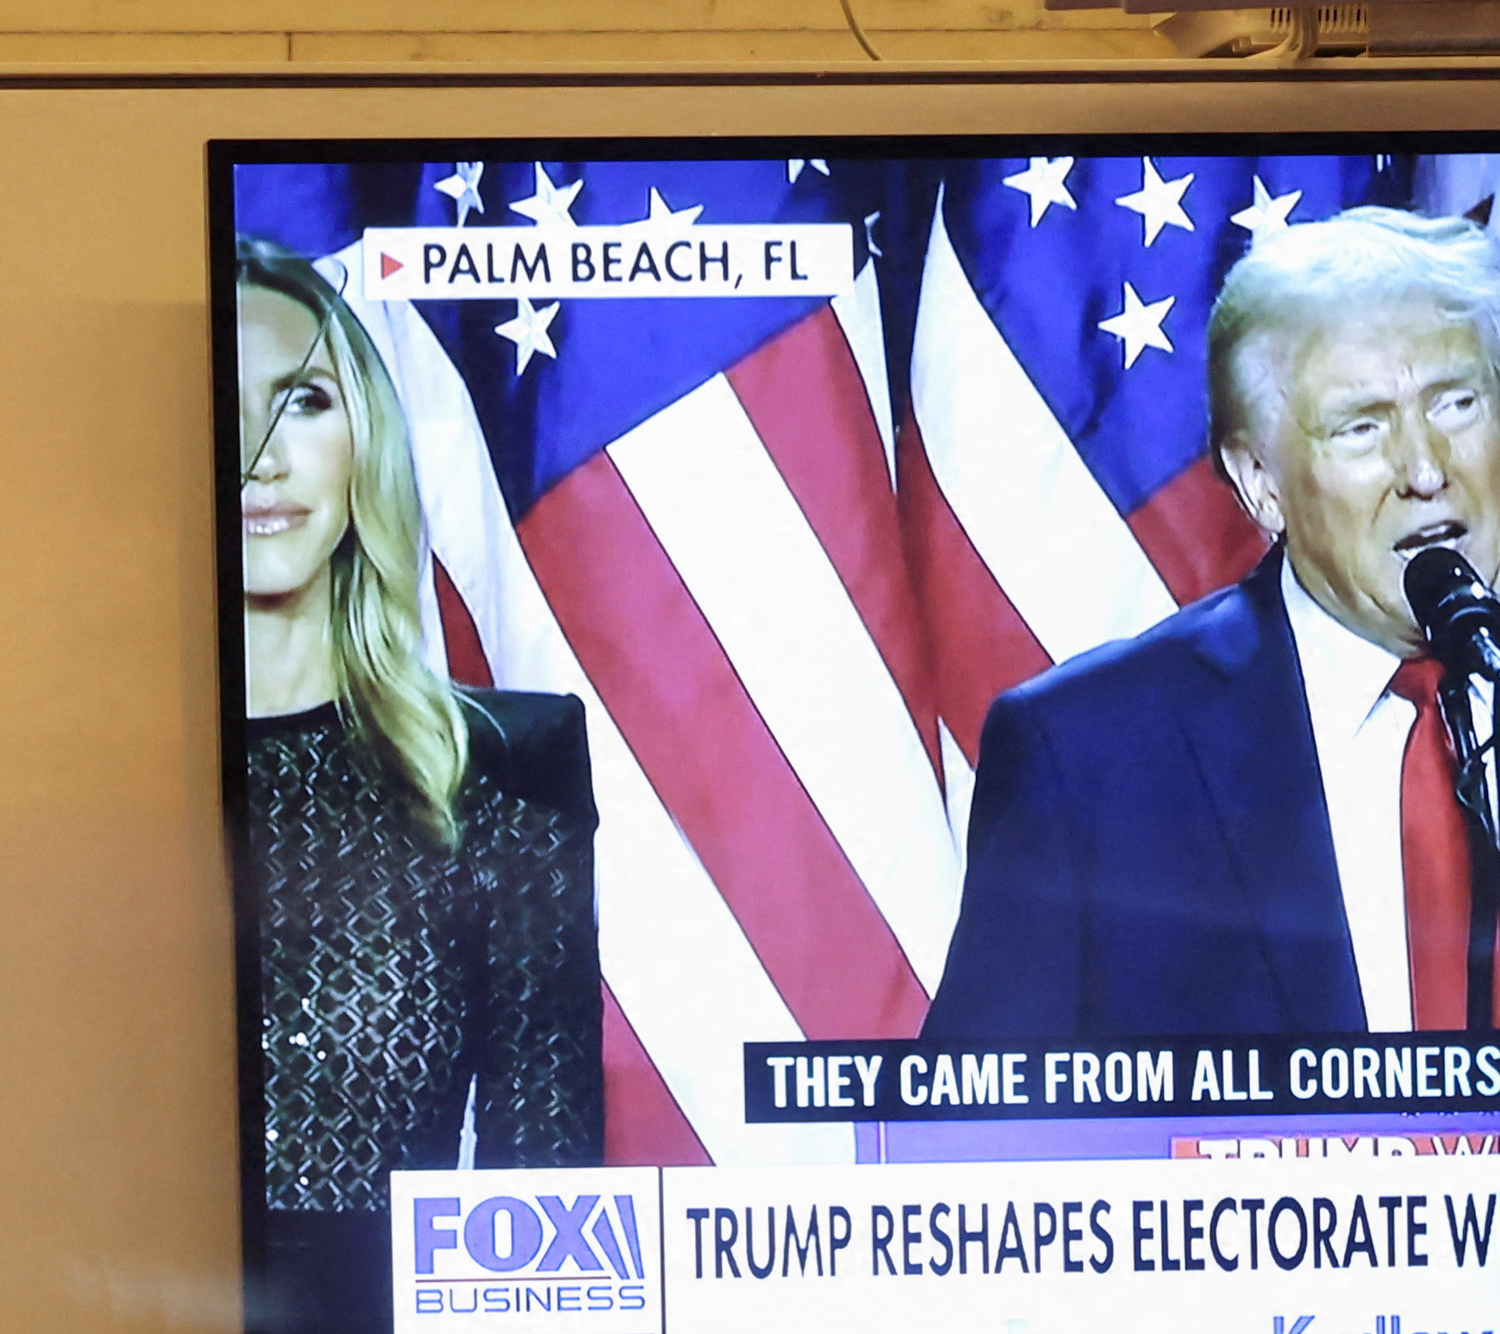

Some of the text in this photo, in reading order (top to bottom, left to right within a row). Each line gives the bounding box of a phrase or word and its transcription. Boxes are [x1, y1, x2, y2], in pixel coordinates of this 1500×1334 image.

[424, 240, 809, 289] PALM BEACH, FL
[766, 1056, 882, 1107] THEY
[900, 1054, 1028, 1105] CAME
[1044, 1051, 1173, 1103] FROM
[1191, 1049, 1274, 1101] ALL
[413, 1195, 625, 1278] FOX
[686, 1204, 852, 1279] TRUMP
[871, 1199, 1115, 1276] RESHAPES
[1132, 1195, 1428, 1271] ELECTORATE
[415, 1285, 646, 1314] BUSINESS
